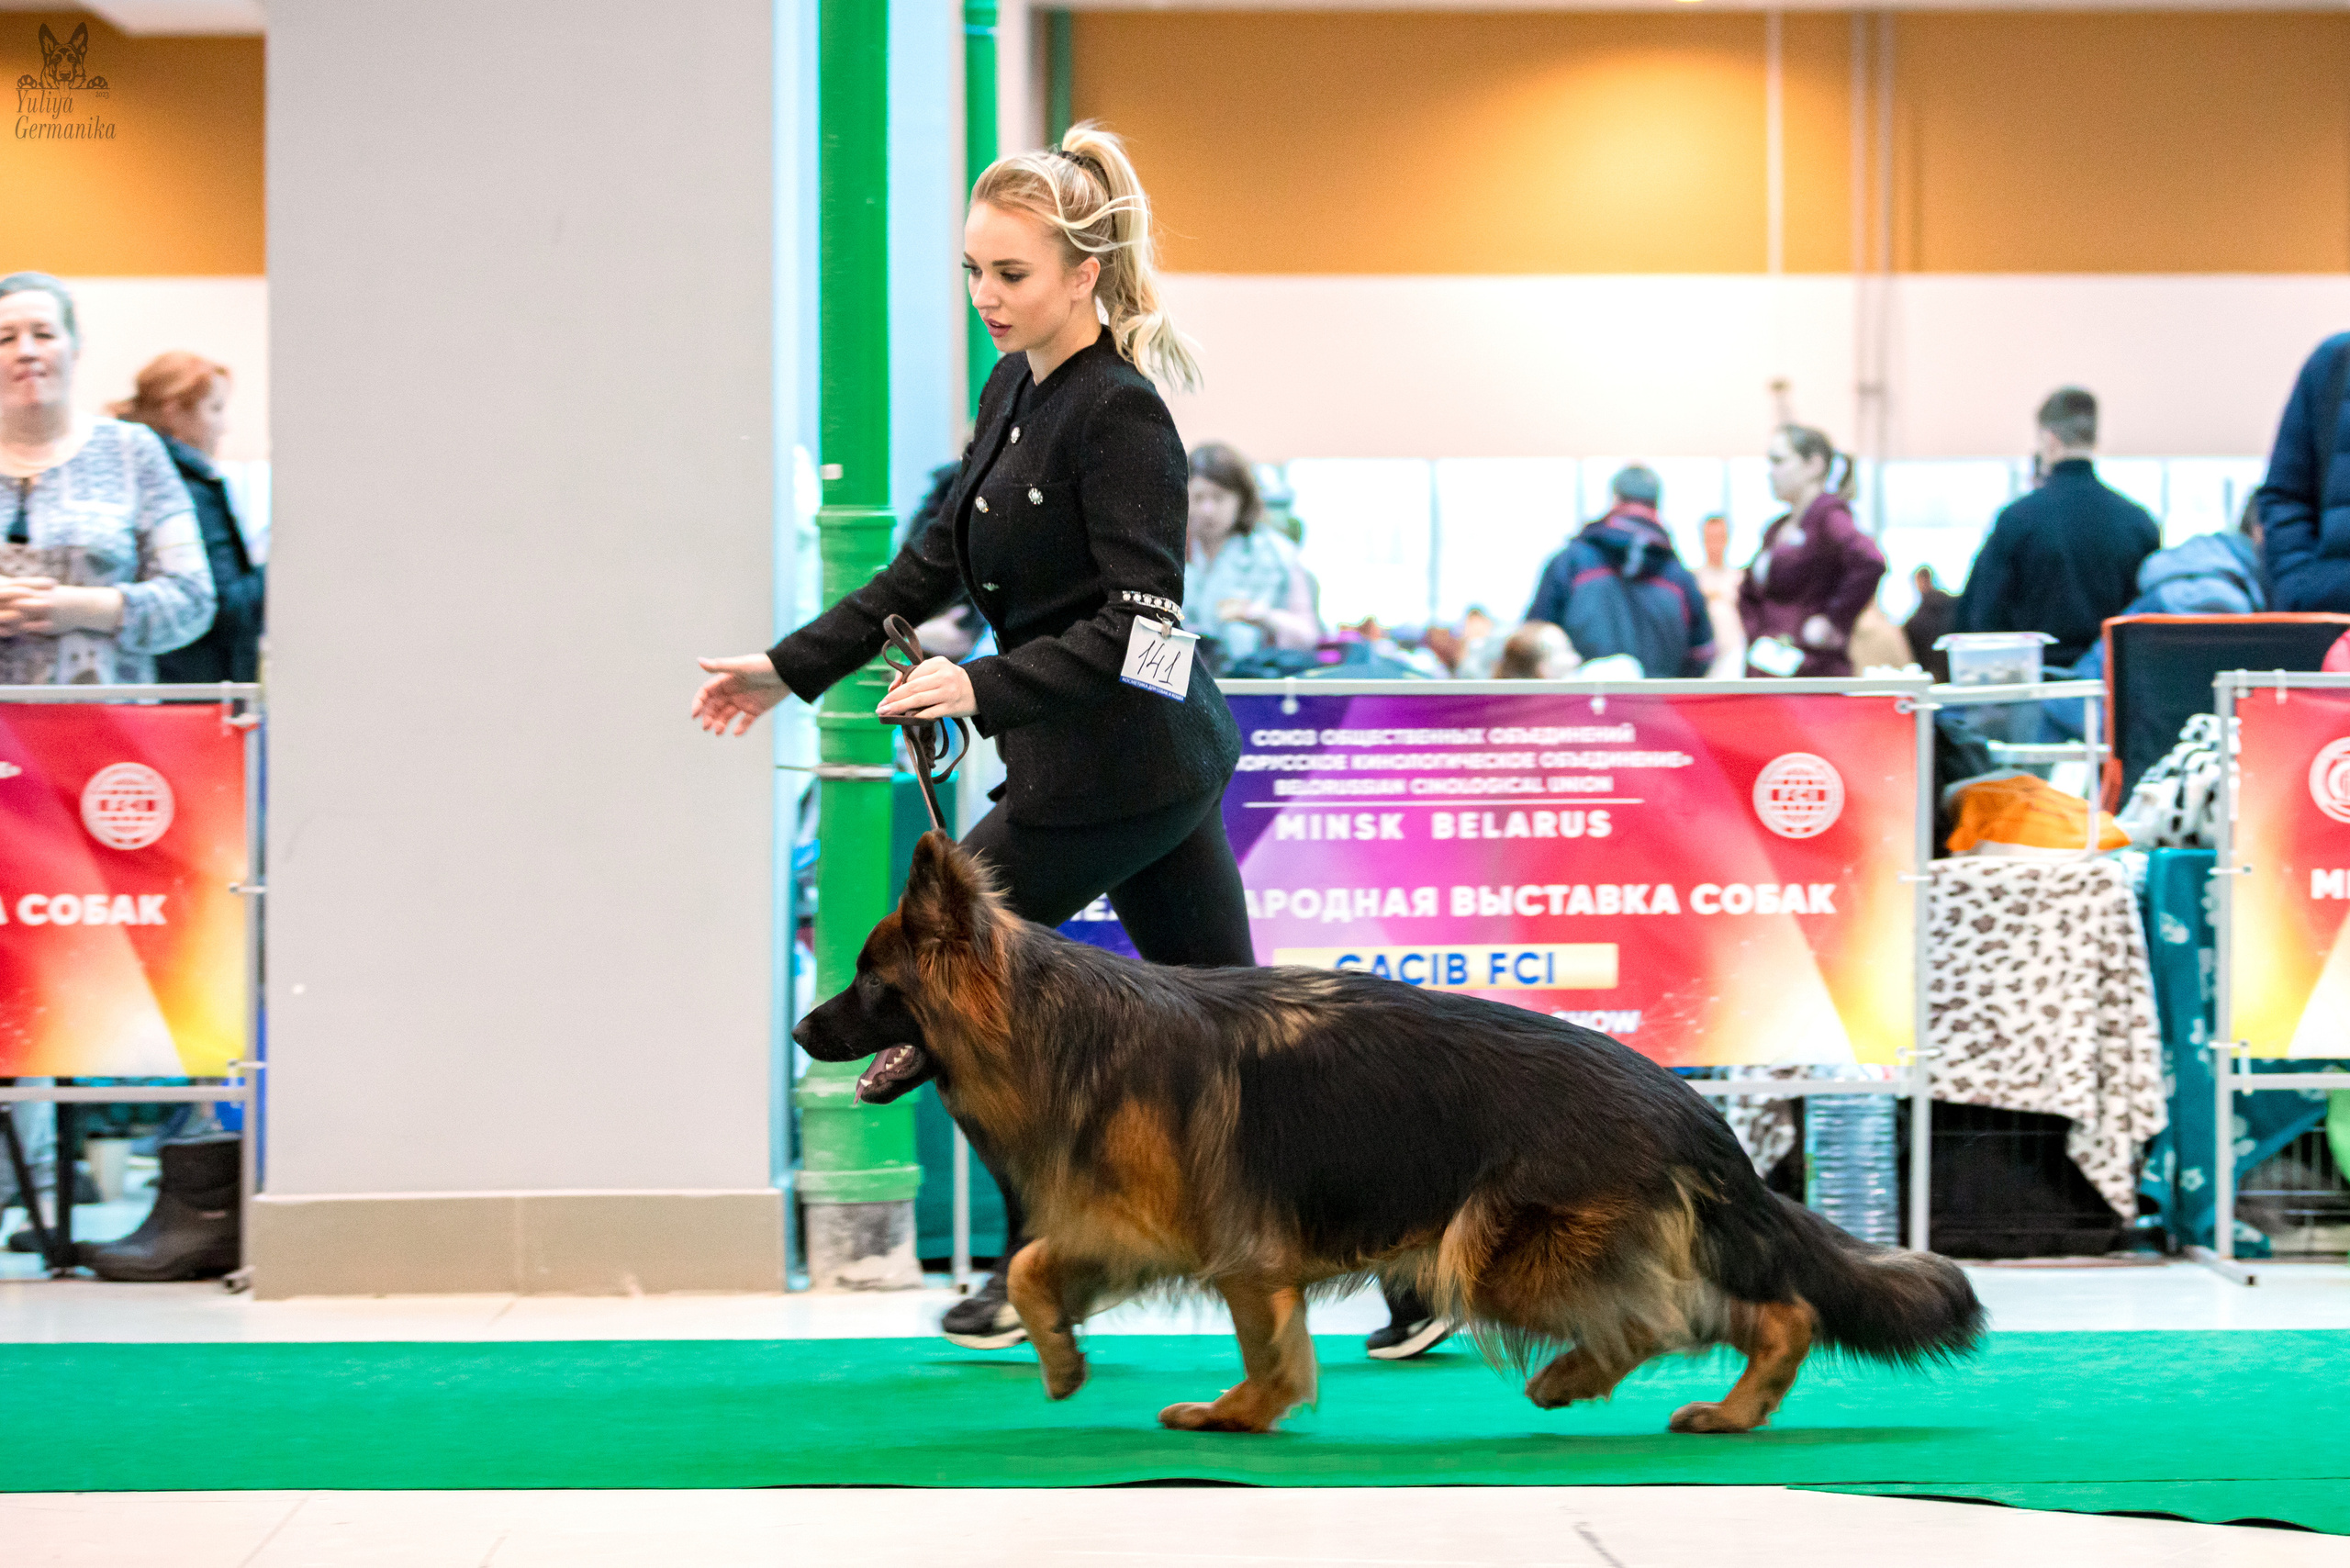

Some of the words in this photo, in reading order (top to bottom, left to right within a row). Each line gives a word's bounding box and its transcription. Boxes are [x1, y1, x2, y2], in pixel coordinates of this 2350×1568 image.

[1137, 640, 1181, 687] 141
[1250, 728, 1318, 746] СОЮЗ
[1546, 776, 1614, 793] UNION
[1275, 813, 1405, 840] MINSK
[1431, 810, 1613, 839] BELARUS
[16, 894, 167, 925] СОБАК
[1450, 883, 1680, 916] ВЫСТАВКА
[1690, 883, 1838, 915] СОБАК
[1488, 951, 1556, 985] FCI
